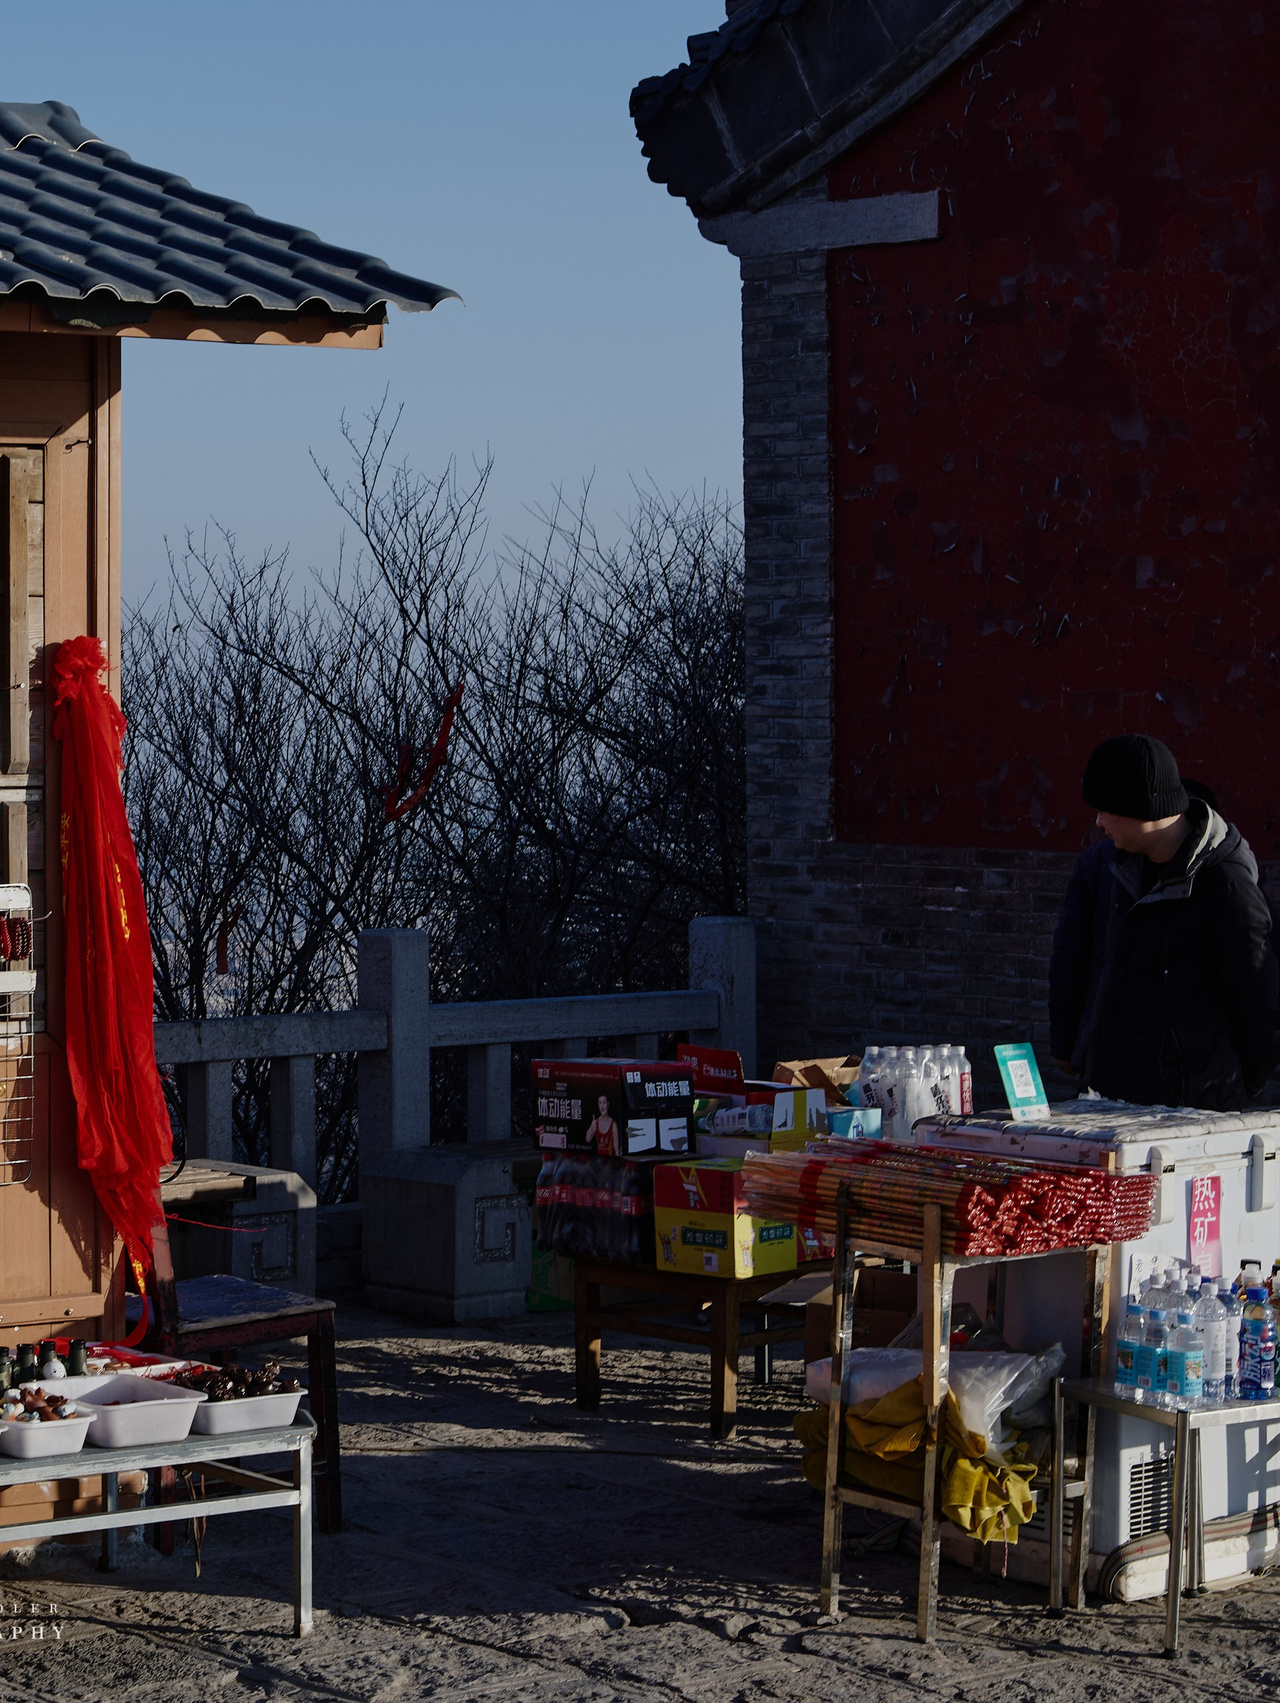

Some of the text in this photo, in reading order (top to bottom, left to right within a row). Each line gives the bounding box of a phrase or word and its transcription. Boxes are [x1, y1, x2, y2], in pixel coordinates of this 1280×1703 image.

[644, 1080, 691, 1098] 体动能量
[537, 1096, 583, 1120] 体动能量
